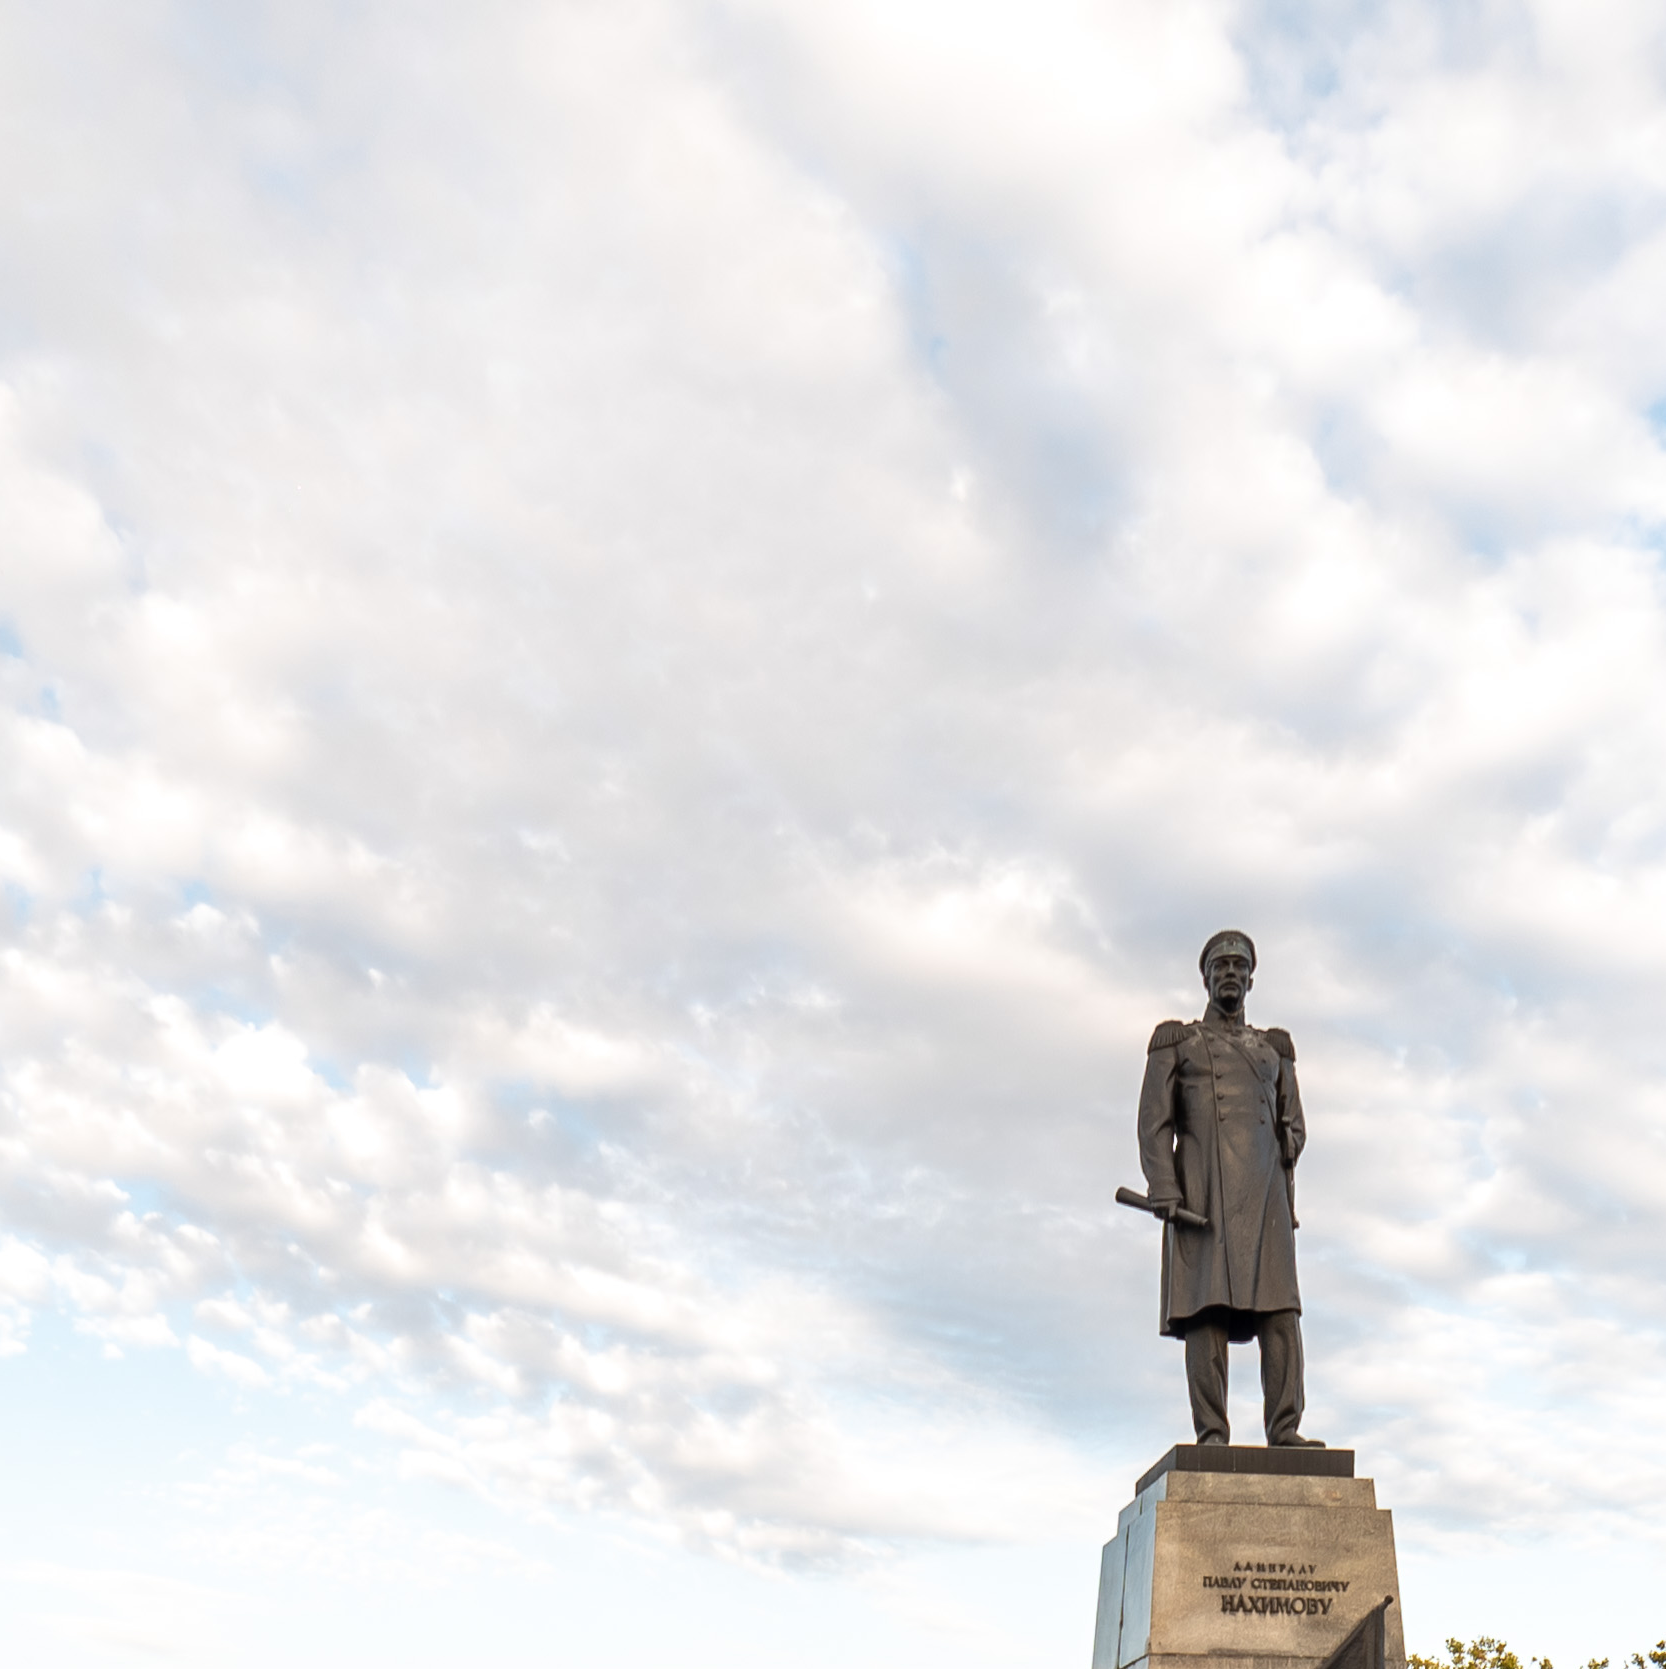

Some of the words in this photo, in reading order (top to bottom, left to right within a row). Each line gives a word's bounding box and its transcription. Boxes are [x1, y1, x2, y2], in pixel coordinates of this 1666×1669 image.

[1233, 1561, 1317, 1575] АДМИРАЛУ
[1202, 1575, 1247, 1589] ПАВЛУ
[1250, 1577, 1350, 1593] СТЕПАНОВИЧУ
[1221, 1593, 1333, 1616] НАХИМОВУ
